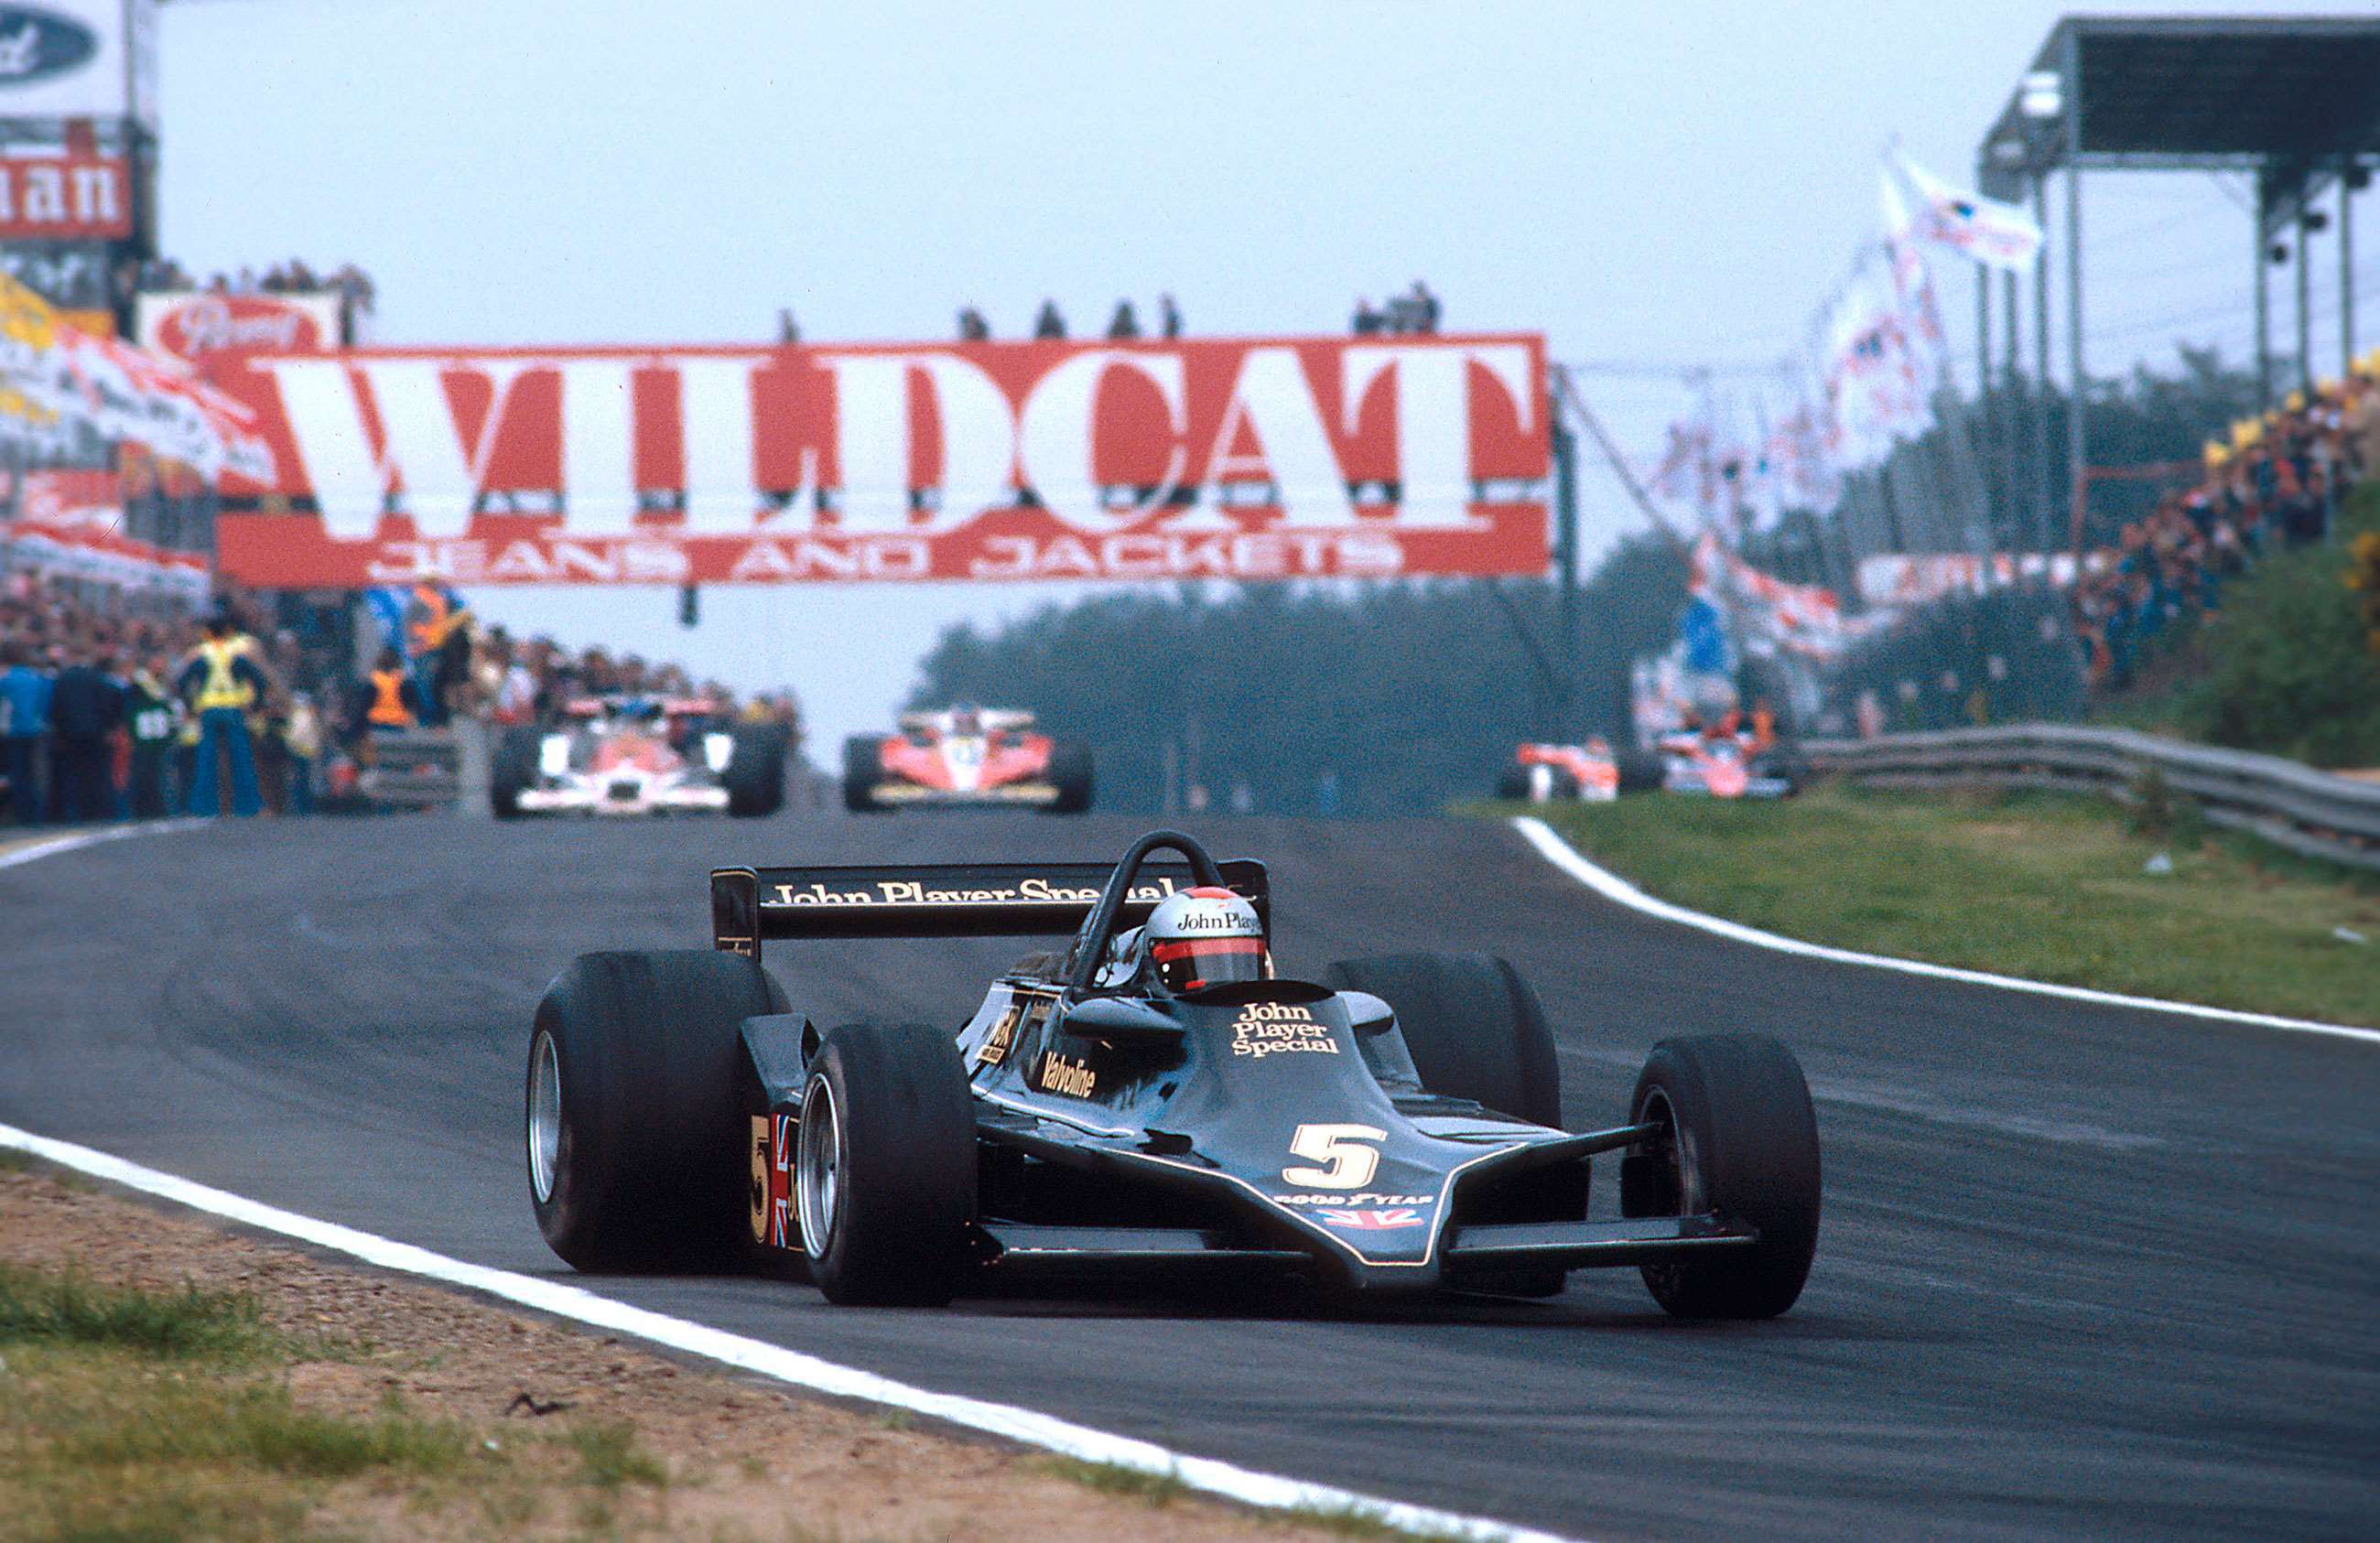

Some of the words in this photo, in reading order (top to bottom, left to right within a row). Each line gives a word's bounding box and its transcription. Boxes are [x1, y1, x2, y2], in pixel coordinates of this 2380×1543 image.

[245, 345, 1535, 543] WILDCAT
[366, 538, 693, 580] JEANS
[732, 534, 930, 578] AND
[968, 532, 1404, 577] JACKETS
[770, 884, 872, 904] John
[1020, 878, 1175, 901] Seal
[1177, 912, 1223, 931] John
[1239, 1001, 1313, 1022] John
[1231, 1020, 1327, 1041] Player
[1231, 1036, 1340, 1059] Special
[1041, 1050, 1096, 1098] Valvoline
[1282, 1124, 1389, 1190] 5
